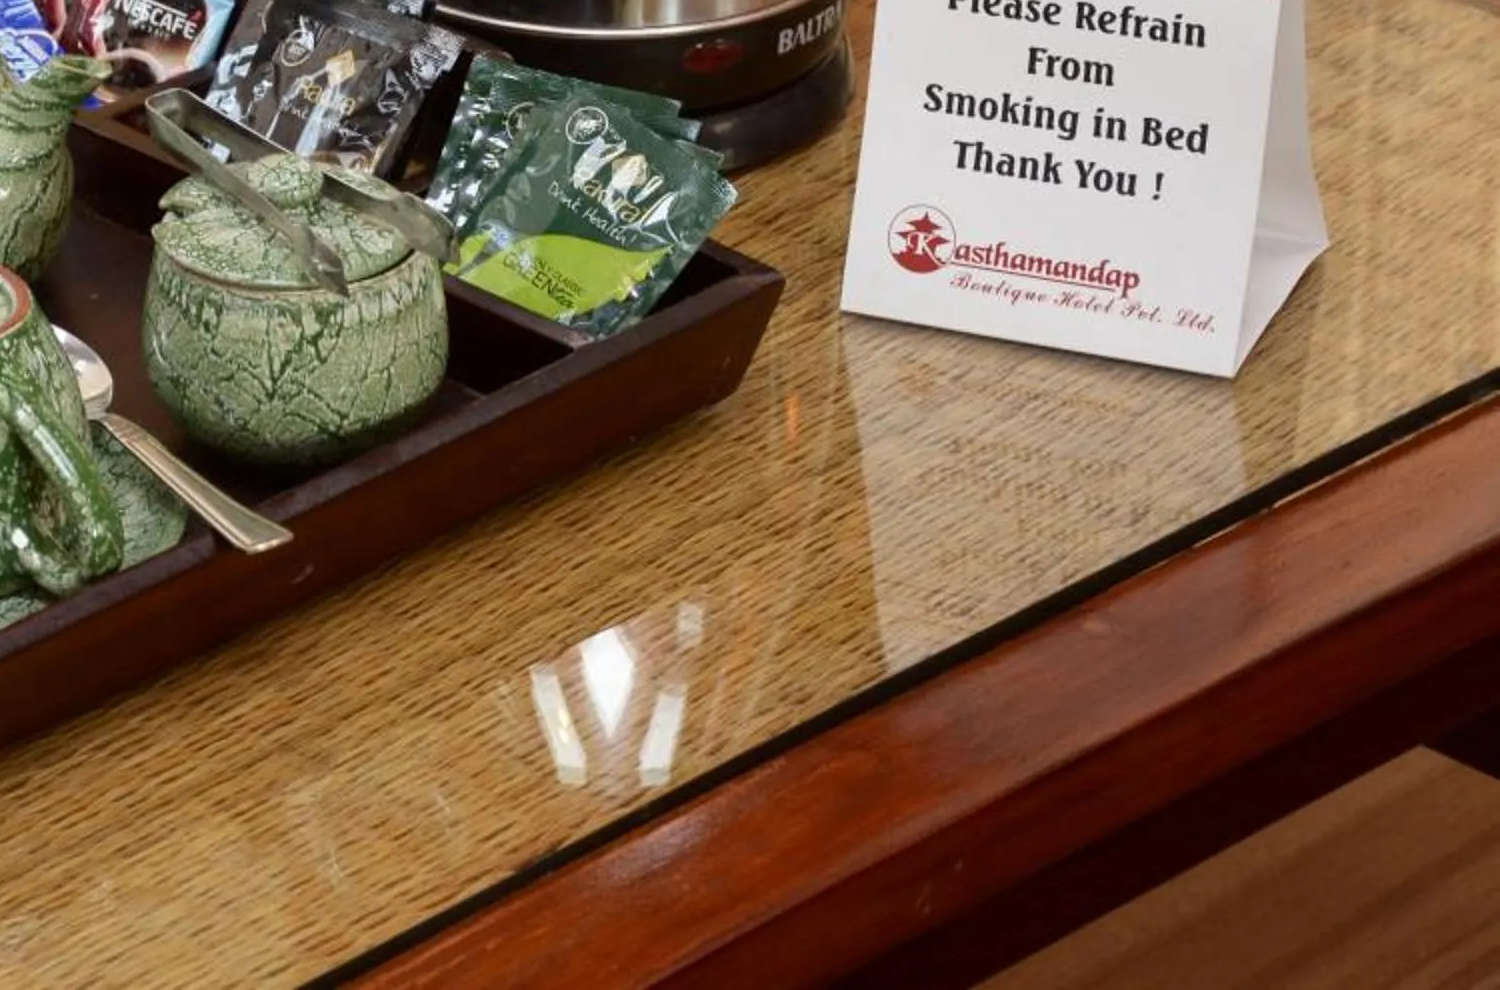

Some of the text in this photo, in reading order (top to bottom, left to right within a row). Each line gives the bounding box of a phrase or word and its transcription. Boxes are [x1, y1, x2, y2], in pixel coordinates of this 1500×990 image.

[1075, 0, 1207, 49] Refrain
[1026, 46, 1115, 87] From
[923, 82, 1209, 155] Smoking in Bed
[953, 140, 1062, 185] Thank
[1074, 159, 1138, 198] You
[949, 271, 1217, 333] Boutique Hotel Pvt. Ltd.
